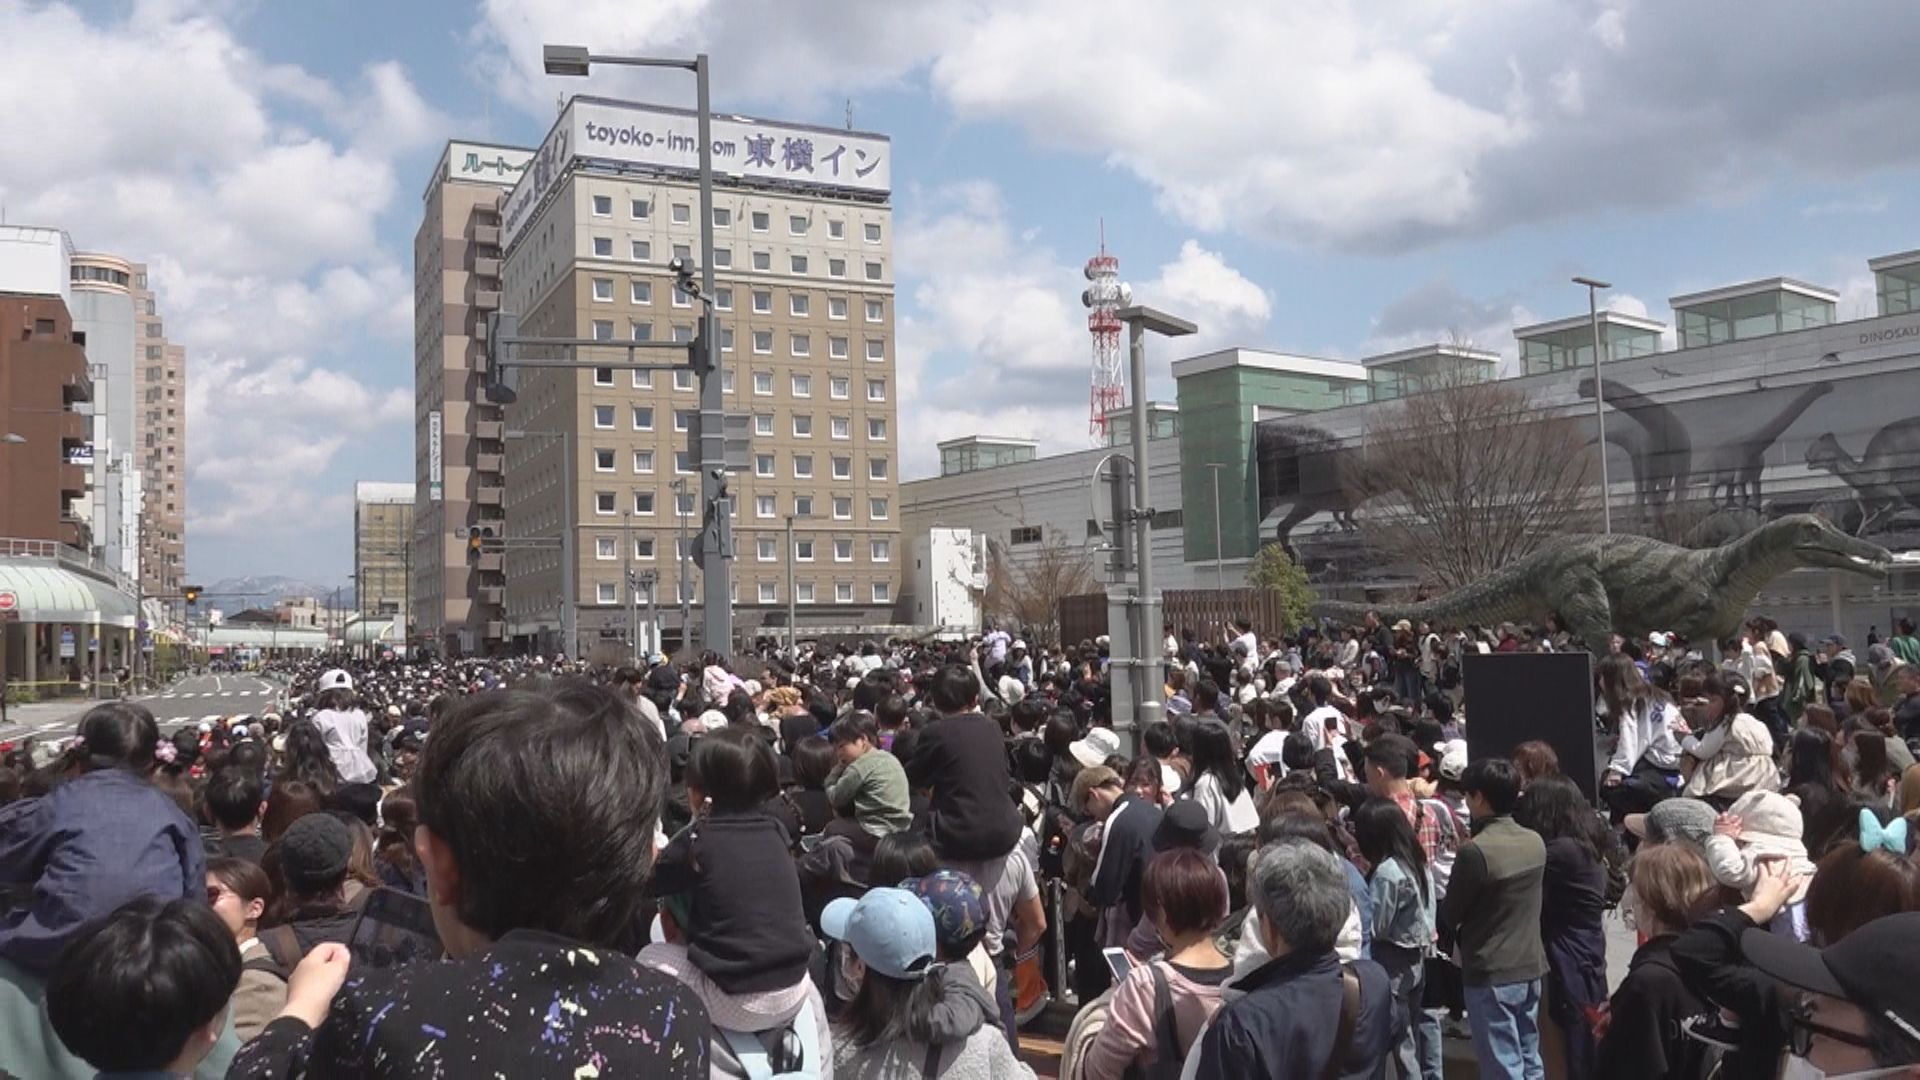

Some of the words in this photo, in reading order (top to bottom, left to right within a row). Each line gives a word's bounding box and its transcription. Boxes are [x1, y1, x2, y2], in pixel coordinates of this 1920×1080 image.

[585, 120, 736, 158] toyoko-inn.om
[743, 132, 881, 178] 東横イン
